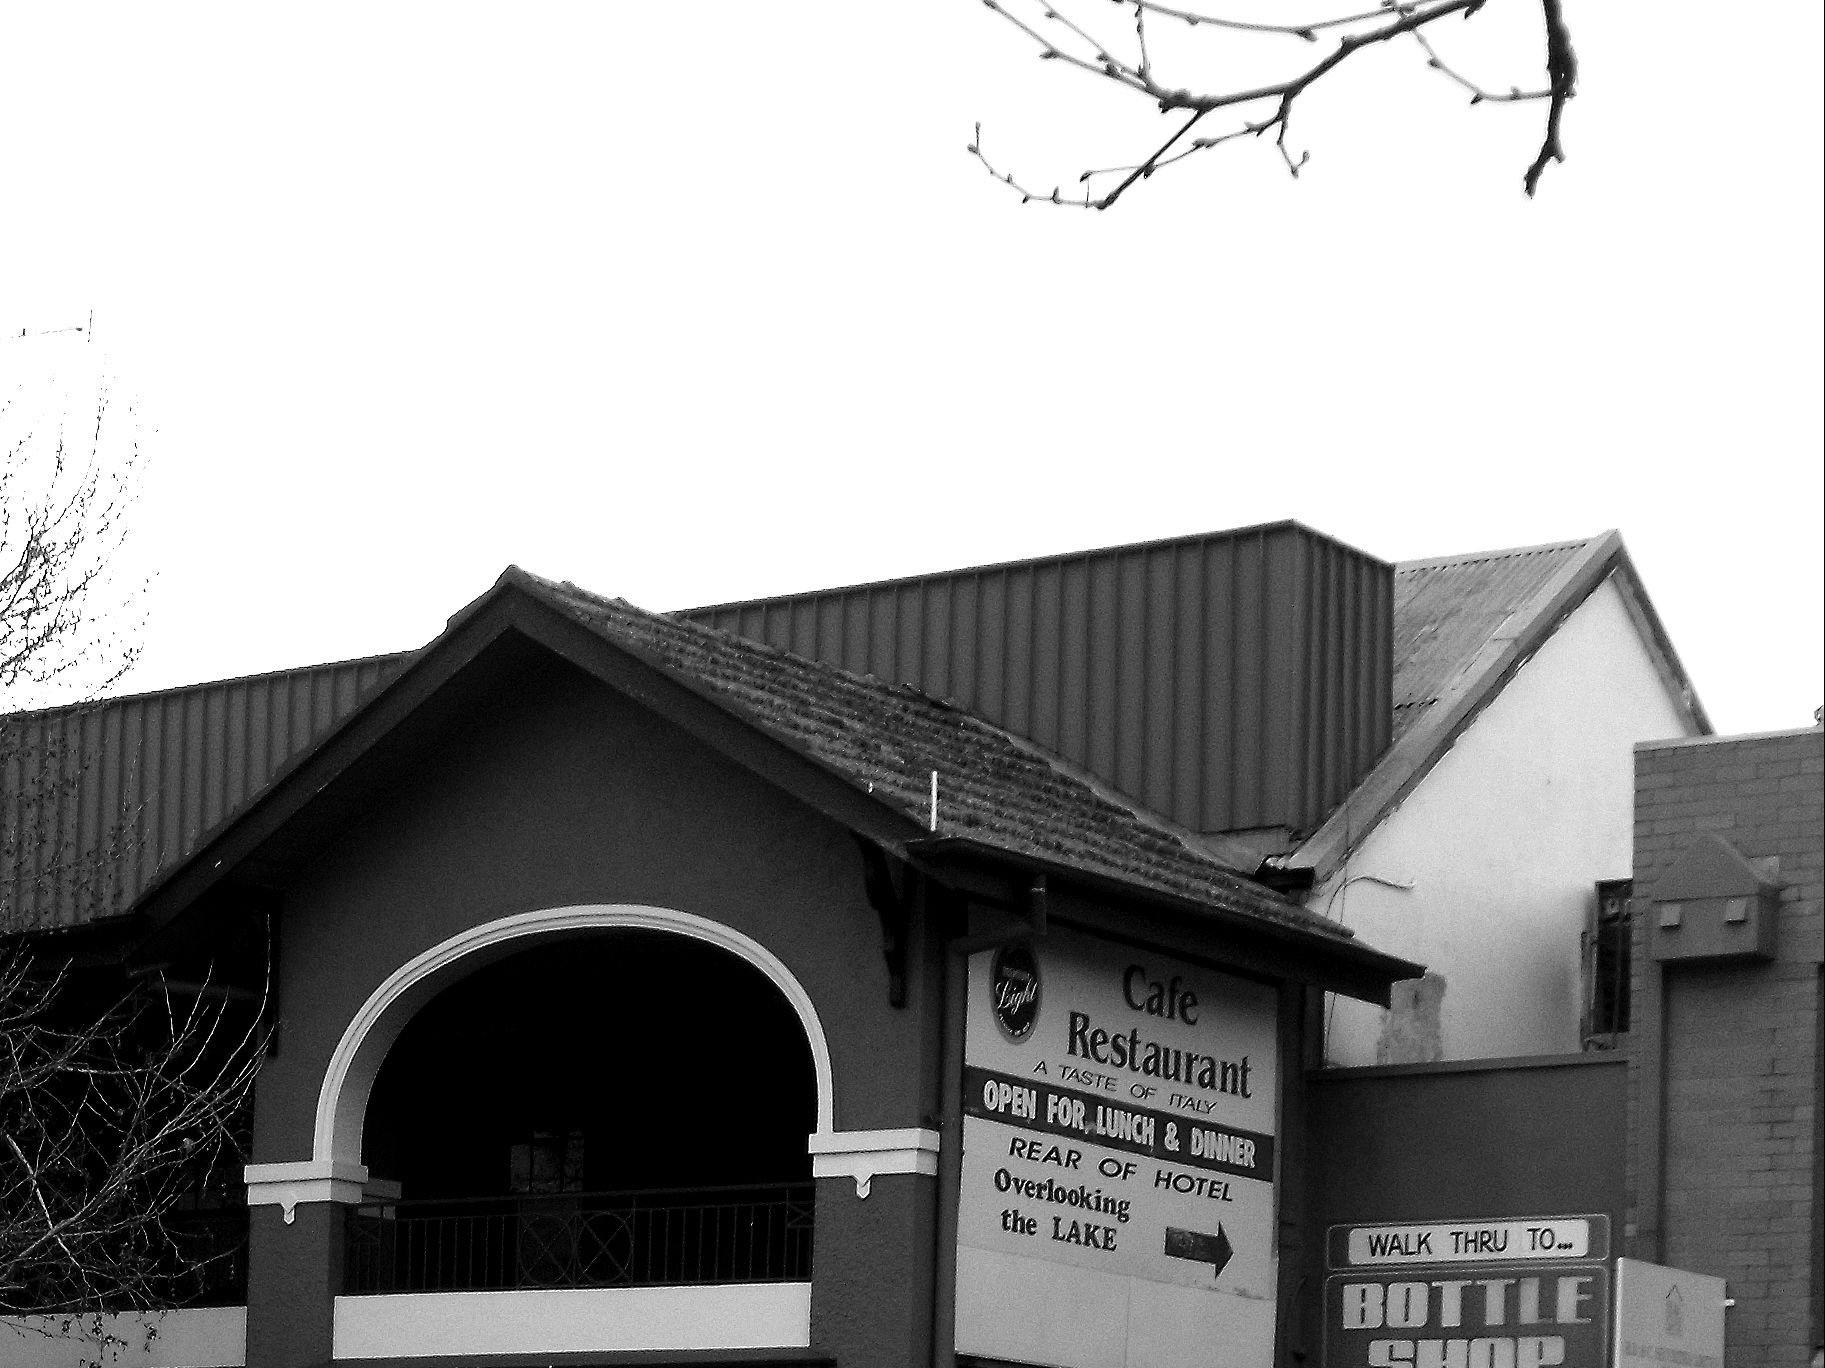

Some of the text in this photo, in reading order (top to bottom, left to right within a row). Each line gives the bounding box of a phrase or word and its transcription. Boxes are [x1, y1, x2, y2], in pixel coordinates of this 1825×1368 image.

[1122, 963, 1199, 1026] Cafe
[1066, 1011, 1253, 1099] Restaurant
[1033, 1059, 1218, 1115] A TASTE OF ITALY
[983, 1079, 1256, 1169] OPEN FOR LUNCH & DINNER
[993, 1167, 1131, 1224] Overlooking
[1009, 1136, 1233, 1202] REAR OF HOTEL
[1001, 1208, 1119, 1253] the LAKE
[1368, 1231, 1433, 1258] WALK
[1449, 1228, 1509, 1254] THRU
[1341, 1277, 1593, 1330] BOTTLE
